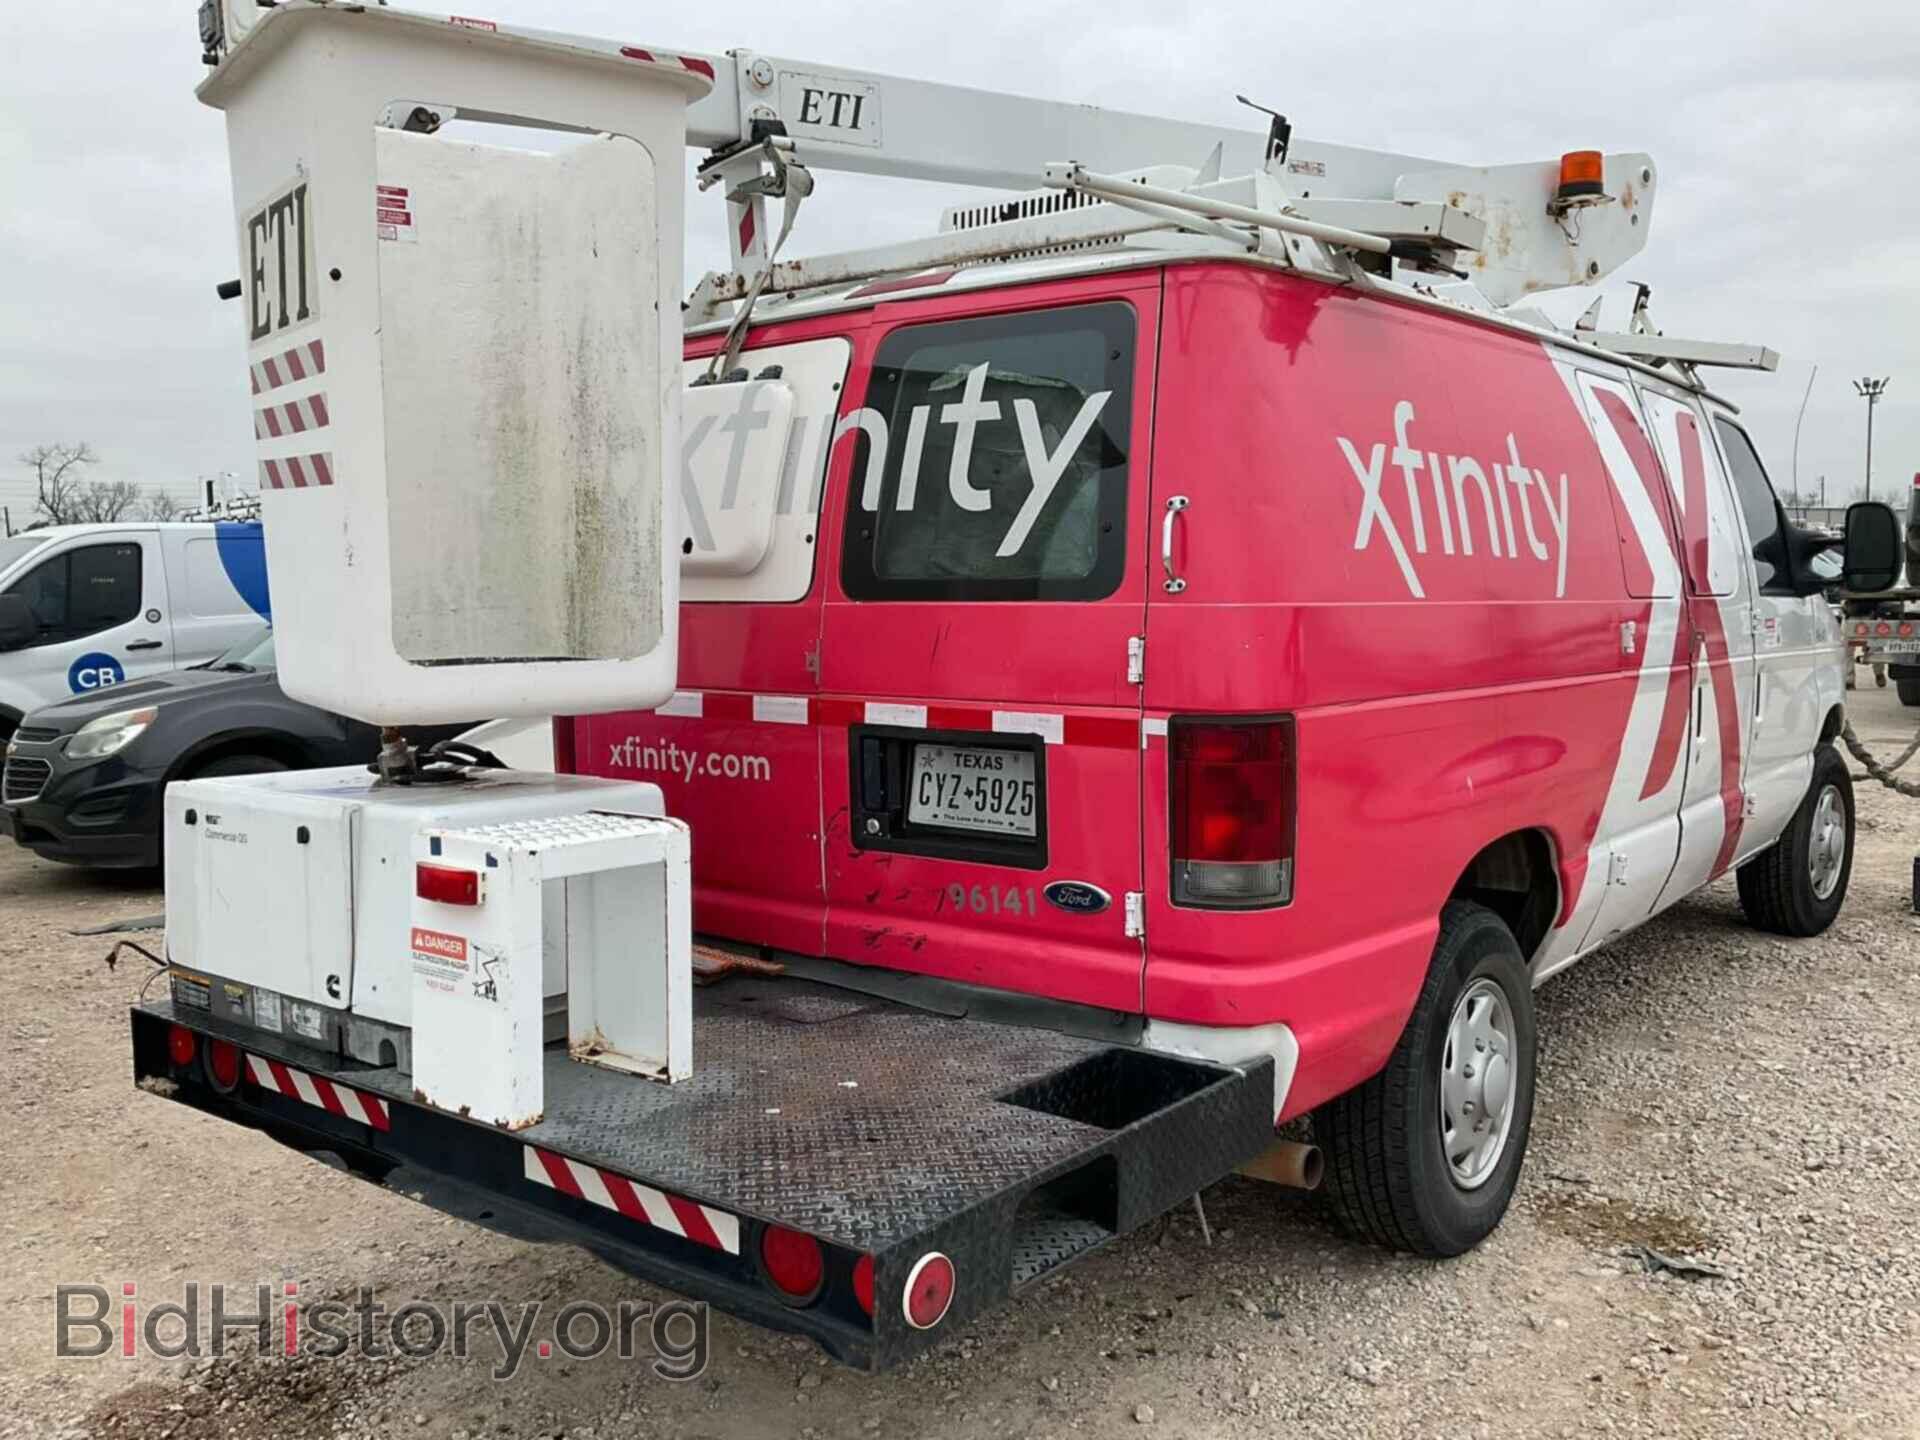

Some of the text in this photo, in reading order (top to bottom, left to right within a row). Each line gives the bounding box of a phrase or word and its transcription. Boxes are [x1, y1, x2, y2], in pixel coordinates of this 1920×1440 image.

[798, 88, 865, 130] ETI
[248, 183, 309, 341] ETI
[1336, 400, 1568, 598] xfinity
[78, 667, 116, 688] CB
[609, 735, 771, 784] xfinity.com
[953, 752, 1003, 770] TEXAS
[950, 882, 1038, 917] 96141
[1057, 886, 1091, 907] Ford
[424, 935, 463, 953] DANGER
